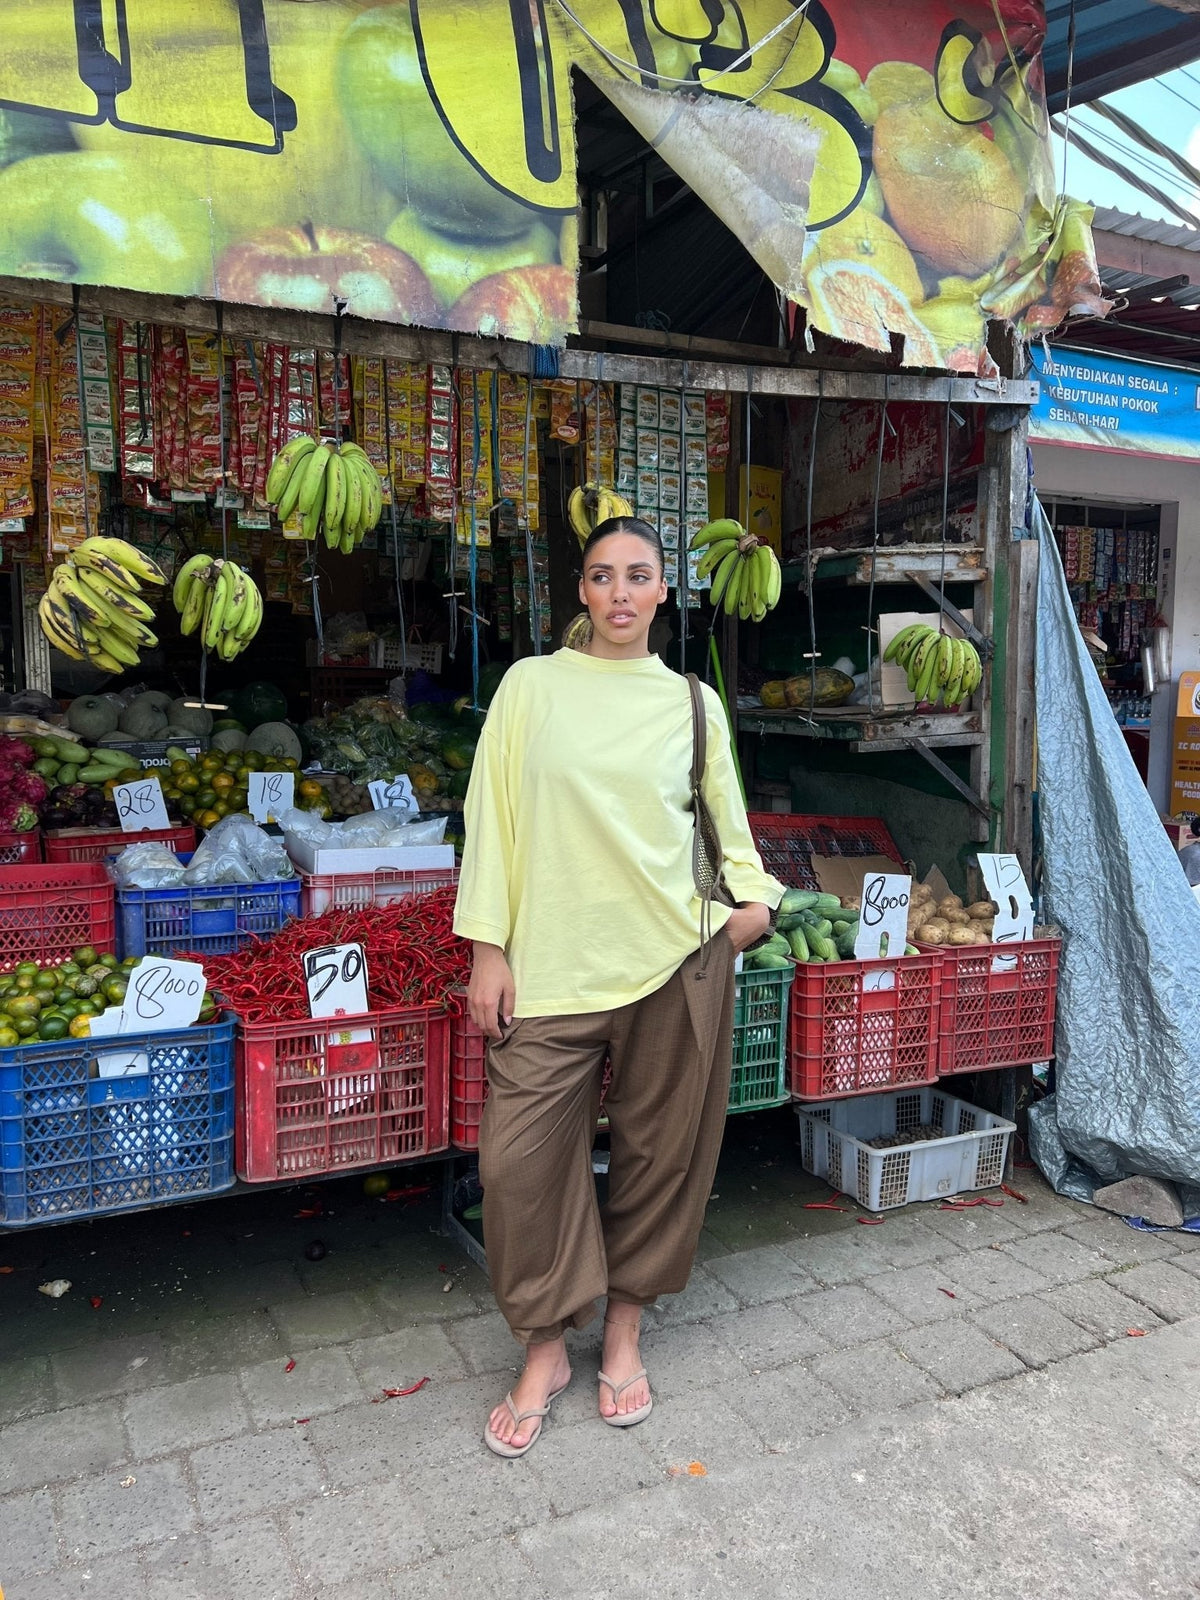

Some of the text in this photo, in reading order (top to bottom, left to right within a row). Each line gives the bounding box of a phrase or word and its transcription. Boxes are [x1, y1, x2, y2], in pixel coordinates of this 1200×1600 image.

[1042, 361, 1125, 387] MENYEDIAKAN
[1128, 375, 1169, 394] SEGALA
[1049, 386, 1119, 408] KEBUTUHAN
[1121, 396, 1159, 414] POKOK
[1049, 407, 1120, 430] SEHARI-HARI
[118, 787, 157, 817] 28
[260, 773, 283, 803] 18
[374, 781, 411, 809] 18
[992, 856, 1021, 889] 15
[862, 876, 909, 927] 8000
[305, 943, 363, 1002] 50
[135, 965, 199, 1019] 8000
